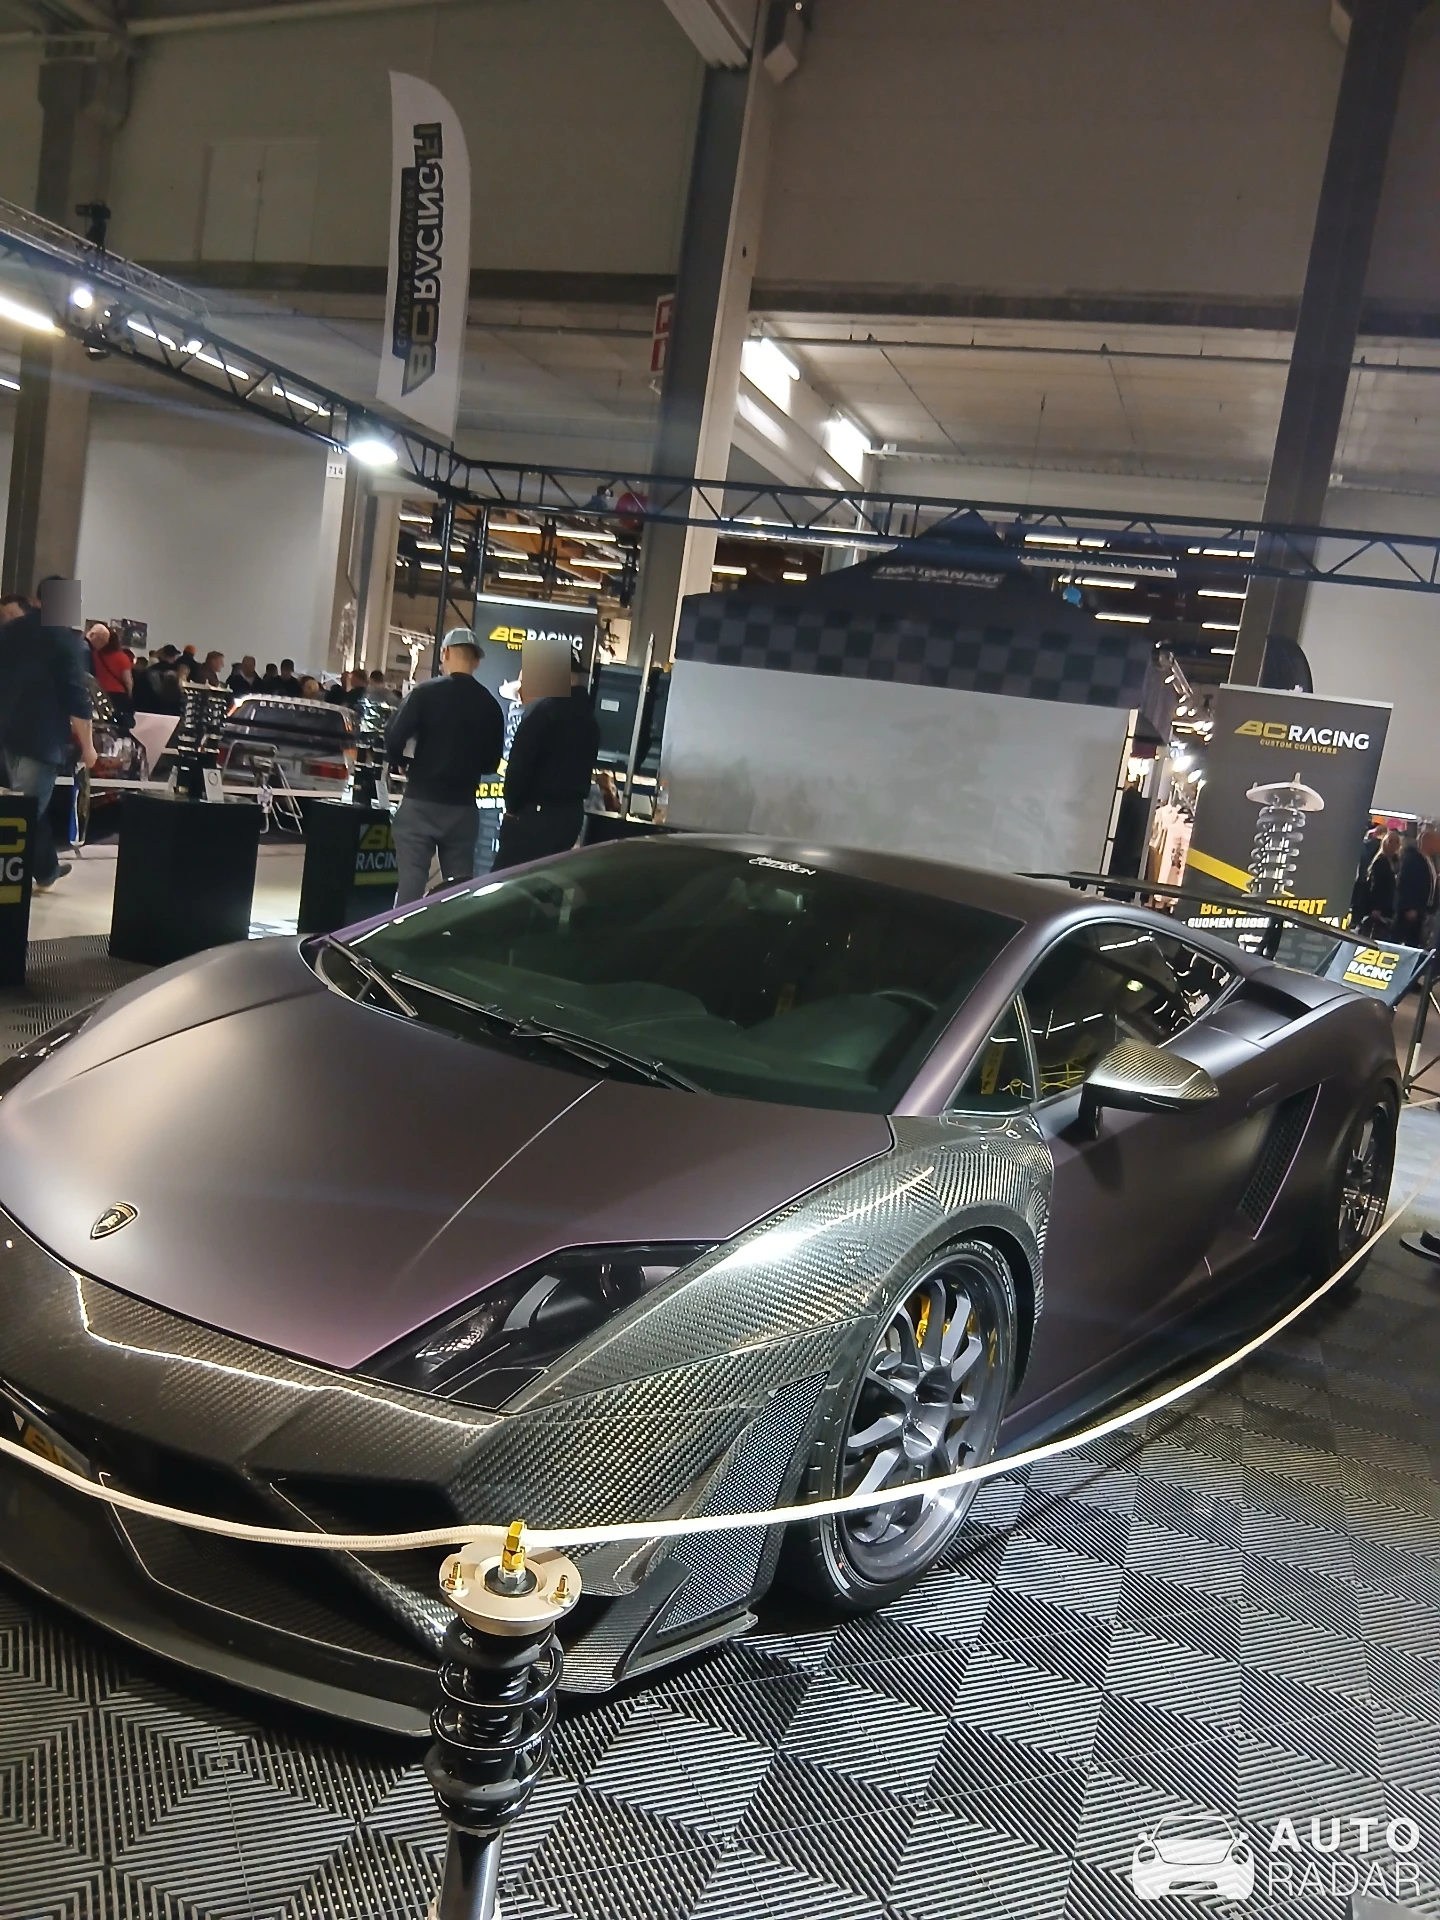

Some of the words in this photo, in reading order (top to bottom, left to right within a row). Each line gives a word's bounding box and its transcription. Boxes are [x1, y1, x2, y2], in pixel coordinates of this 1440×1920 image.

[1260, 738, 1292, 749] CUSTOM
[1294, 742, 1338, 755] COILOVERS
[355, 852, 398, 871] RACIN
[1187, 917, 1234, 928] SUOMEN
[1353, 947, 1400, 970] BC
[1346, 960, 1394, 982] RACING
